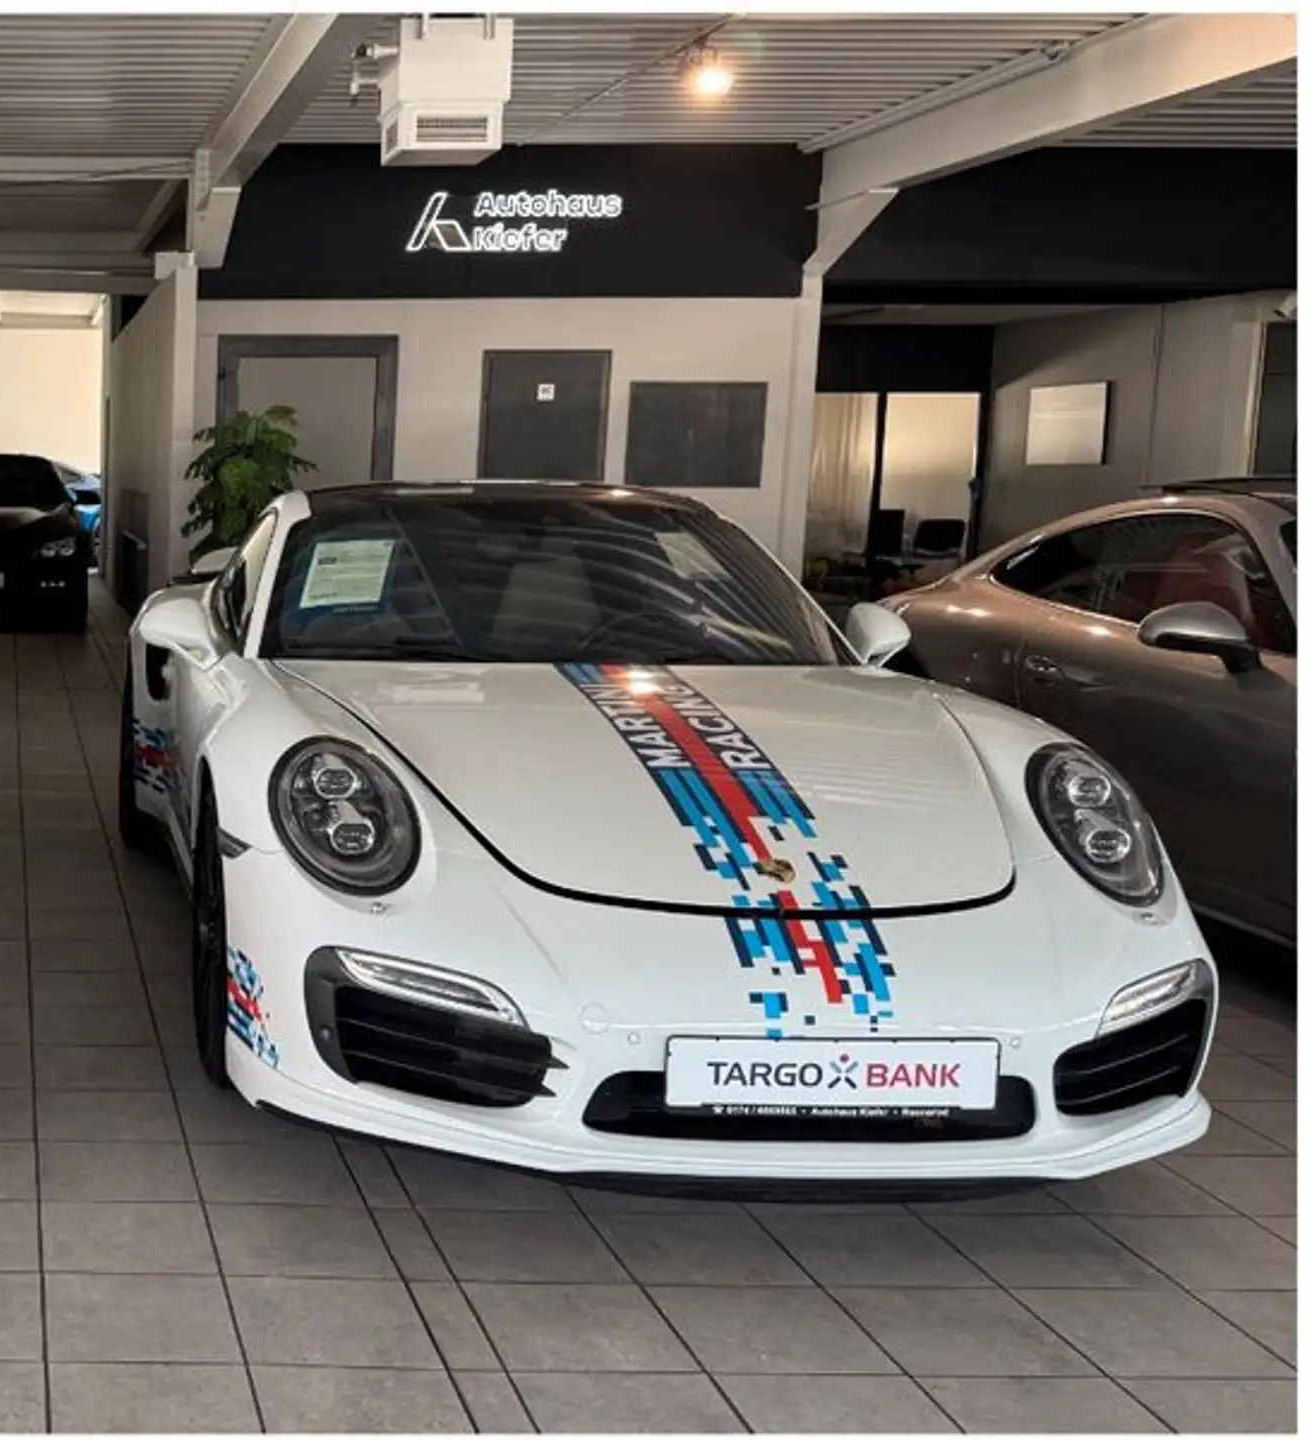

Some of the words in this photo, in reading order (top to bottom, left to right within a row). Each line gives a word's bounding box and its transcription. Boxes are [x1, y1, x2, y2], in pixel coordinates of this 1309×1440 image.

[474, 189, 622, 217] Autohaus
[473, 222, 568, 251] Kiefer
[580, 684, 693, 768] MARTINI
[664, 683, 774, 769] RACING
[707, 1061, 823, 1087] TARGO
[866, 1063, 961, 1088] BANK
